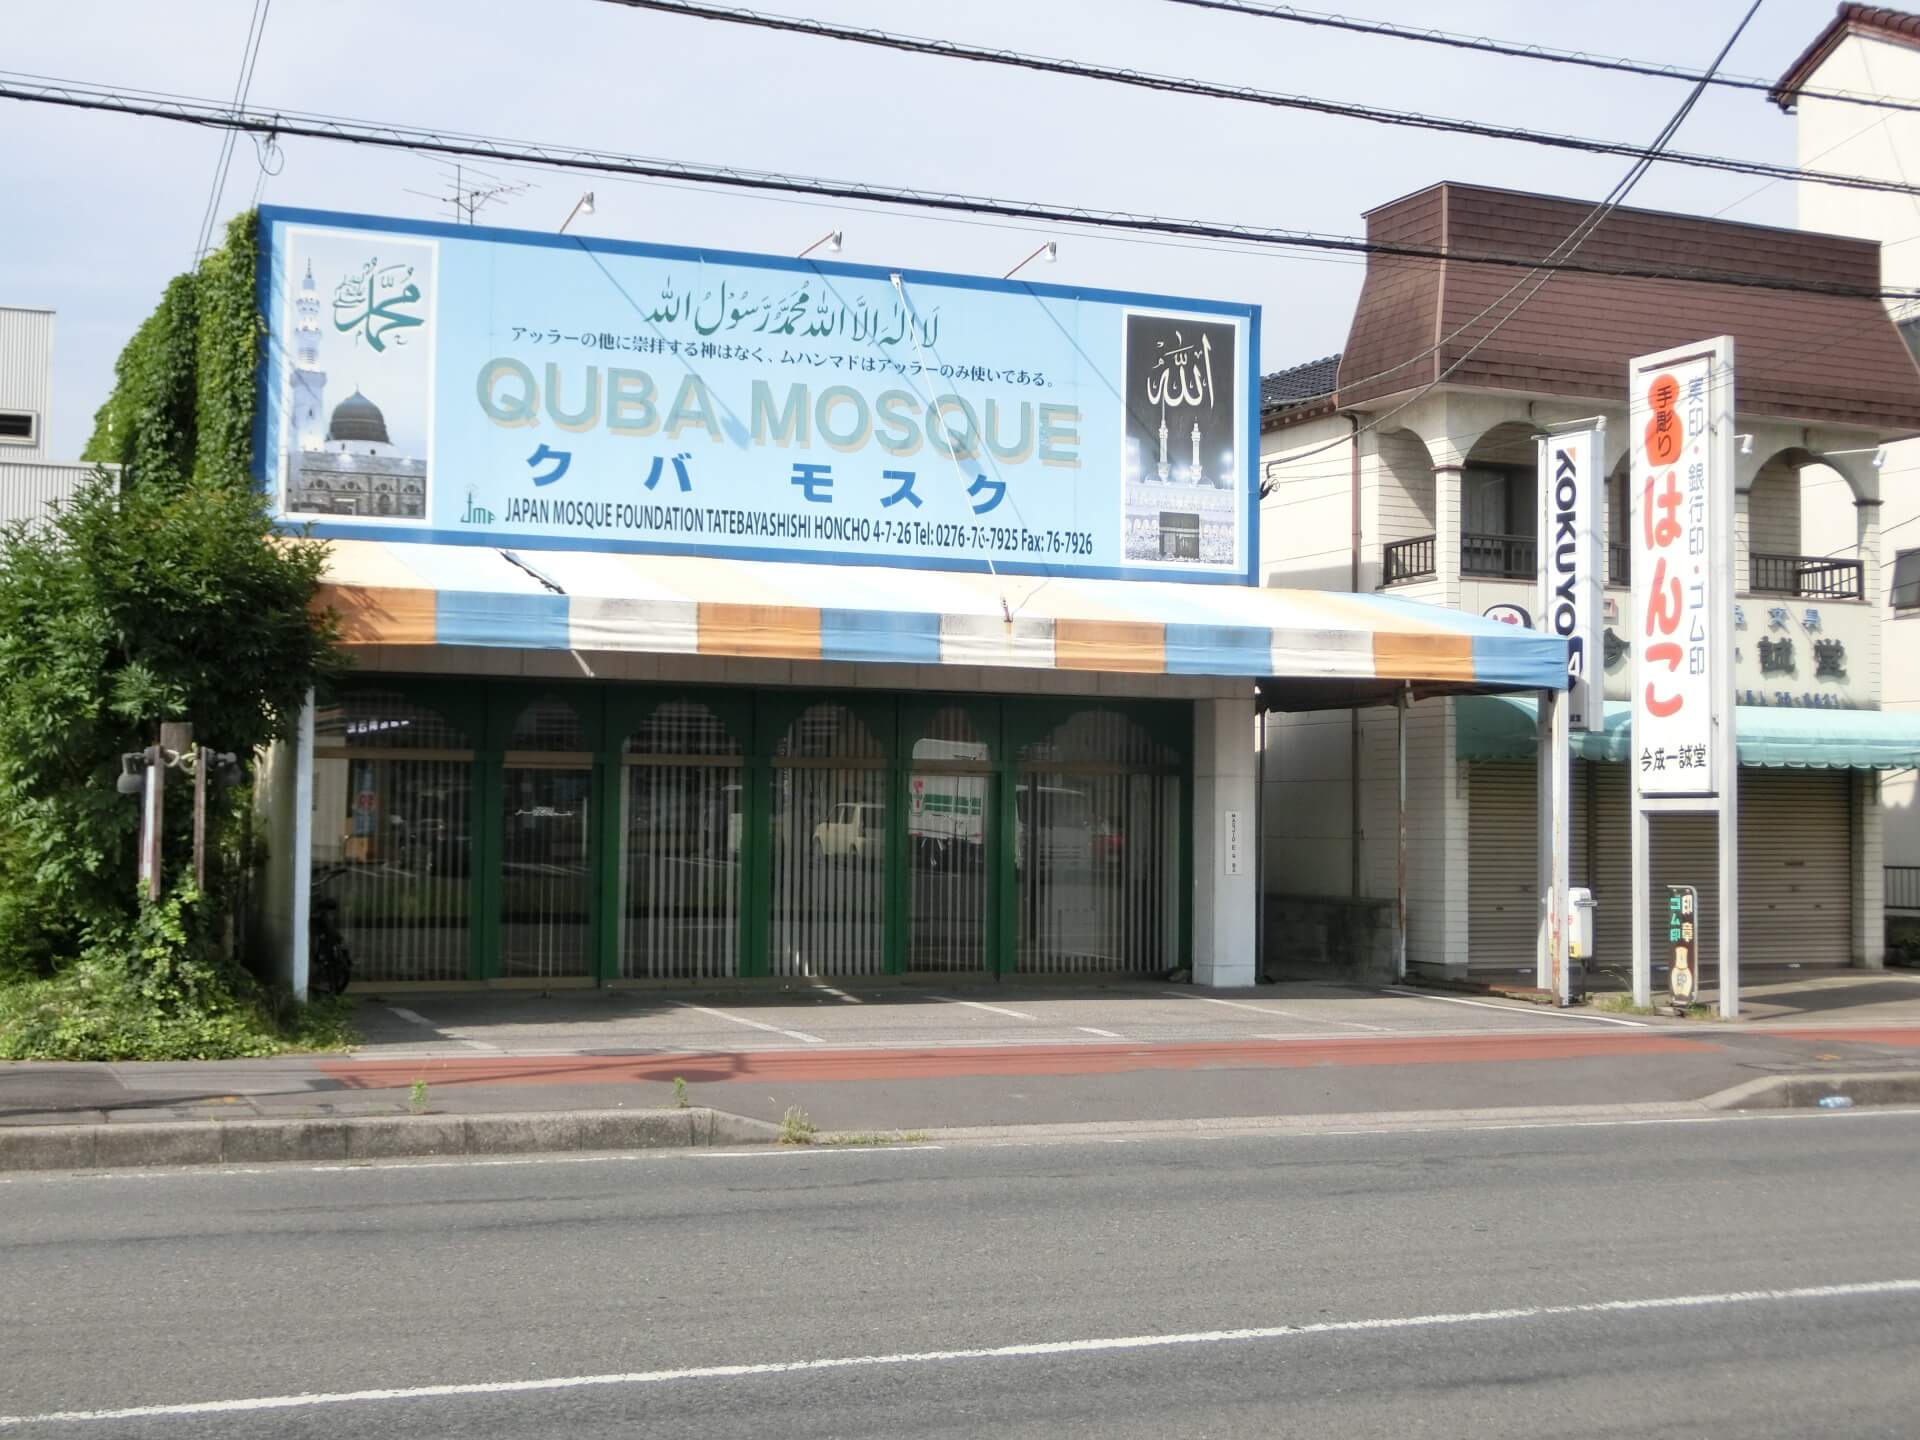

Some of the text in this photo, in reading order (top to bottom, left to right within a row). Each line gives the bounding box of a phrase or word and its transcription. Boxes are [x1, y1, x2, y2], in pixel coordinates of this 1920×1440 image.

[643, 275, 692, 323] الله
[476, 356, 1082, 469] QUBA MOSQUE
[1655, 384, 1673, 458] 手彫り
[526, 443, 1006, 515] クバモスク
[505, 497, 1093, 555] JAPAN MOSQUE FOUNDATION TATEBAYASHISHI HONCHO 4-7-26 Tel: 0276-76-7925 Fax: 76-7926
[1554, 446, 1577, 637] KOKUYO
[1688, 376, 1705, 676] 実印・銀行印・ゴム印
[1644, 470, 1684, 718] はんこ
[1640, 743, 1707, 772] 今成一誠堂
